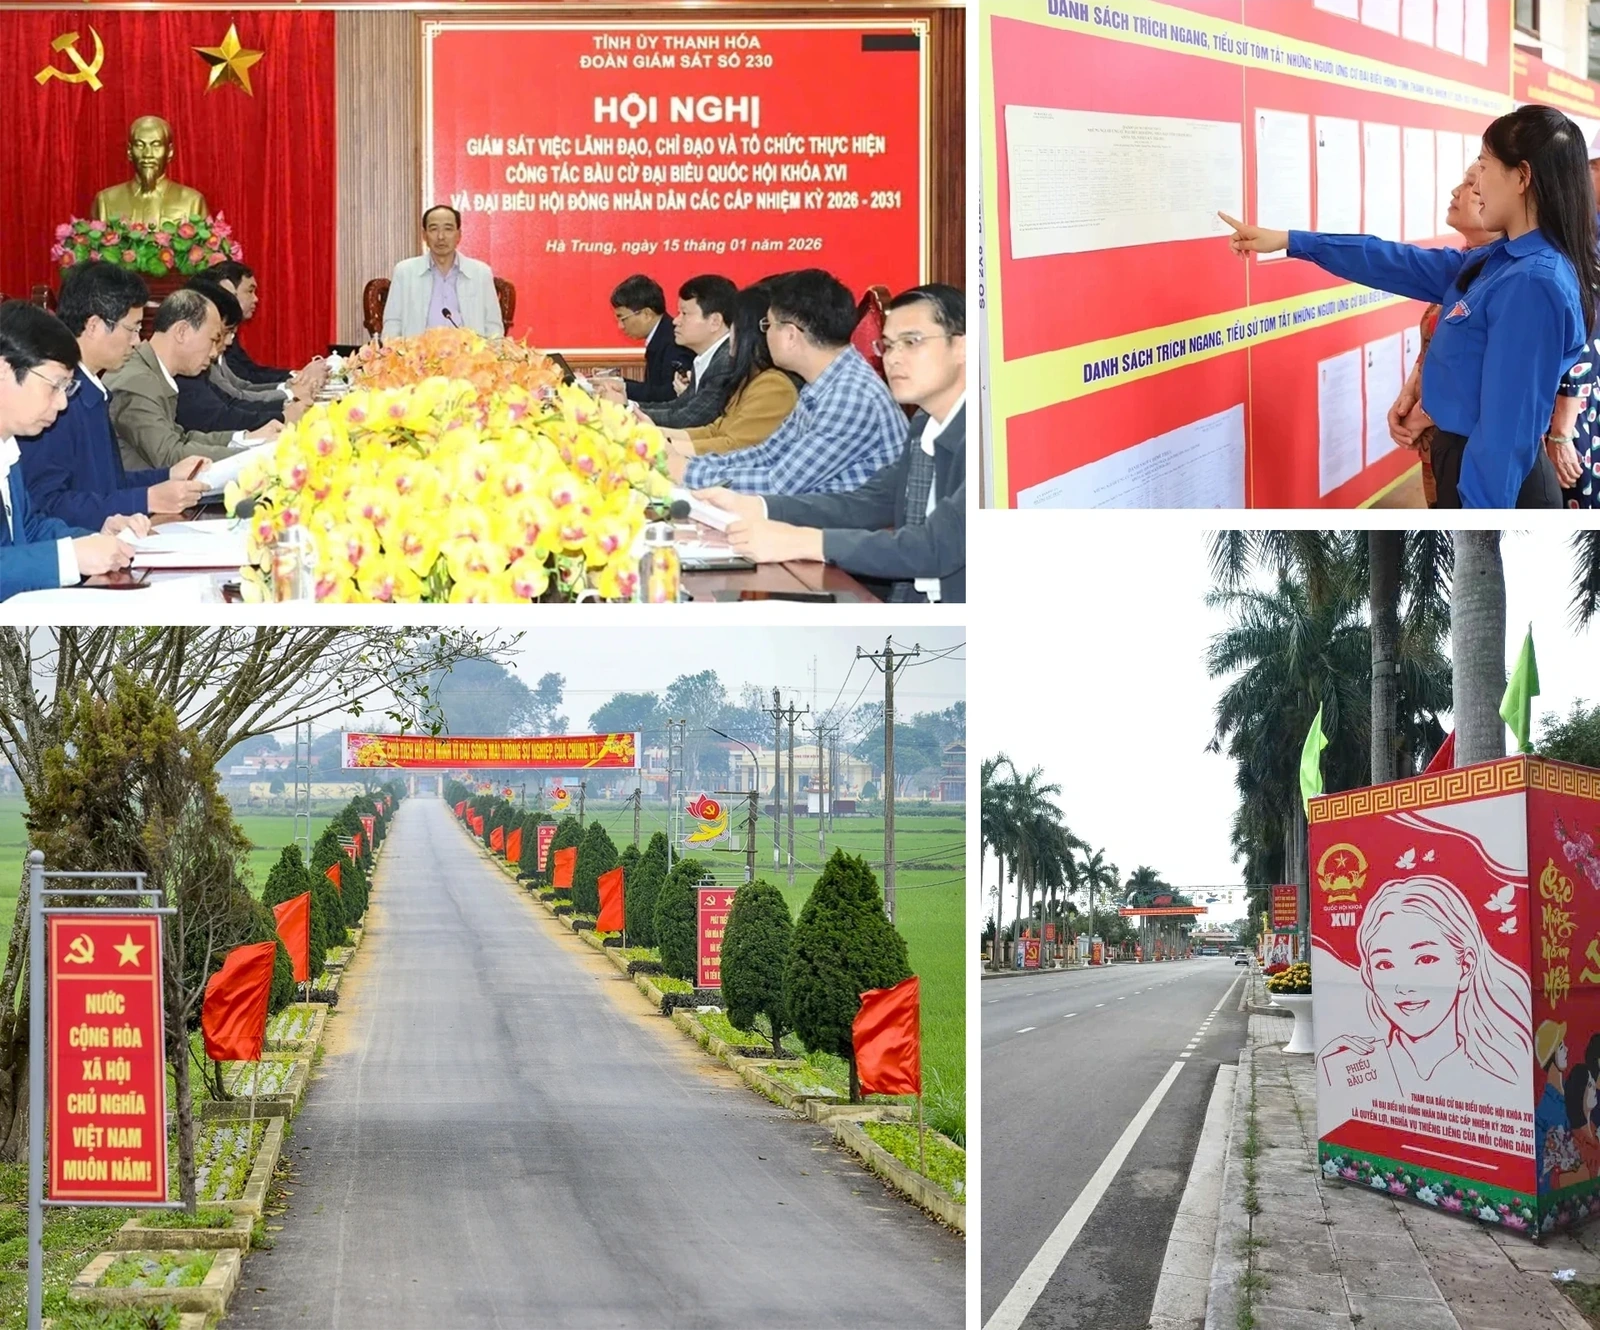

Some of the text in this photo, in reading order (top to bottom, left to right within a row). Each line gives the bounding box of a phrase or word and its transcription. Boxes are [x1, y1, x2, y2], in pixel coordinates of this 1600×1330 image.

[593, 33, 761, 49] TỈNH ỦY THANH HÓA
[1048, 0, 1089, 22] DANH
[1093, 5, 1129, 31] SÁCH
[1133, 16, 1168, 40] TRÍCH
[1170, 25, 1210, 50] NGANG,
[1213, 31, 1234, 54] TIỂU
[1251, 43, 1268, 61] TÓM
[580, 52, 773, 68] ĐOÀN GIÁM SÁT SỐ 230
[594, 92, 760, 129] HỘI NGHỊ
[466, 133, 885, 159] GIÁM SÁT VIỆC LÃNH ĐẠO, CHỈ ĐẠO VÀ TỔ CHỨC THỰC HIỆN
[505, 160, 847, 186] CÔNG TÁC BẦU CỬ ĐẠI BIỂU QUỐC HỘI KHÓA XVI
[450, 187, 901, 214] VÀ ĐẠI BIỂU HỘI ĐỒNG NHÂN DÂN CÁC CẤP NHIỆM KỲ 2026 2031
[545, 238, 822, 255] Hà Trung, ngày 15 tháng 01 năm 2026
[1083, 357, 1118, 383] DANH
[1122, 349, 1153, 372] SÁCH
[1156, 339, 1185, 363] TRÍCH
[1189, 330, 1224, 353] NGANG,
[1227, 319, 1244, 342] TIỂU
[1247, 316, 1258, 337] SỬ
[1260, 315, 1275, 333] TÓM
[1278, 309, 1290, 328] TẮT
[1331, 912, 1355, 927] XVI
[86, 990, 125, 1015] NƯỚC
[69, 1023, 142, 1052] CỘNG HÒA
[82, 1056, 131, 1085] XÃ HỘI
[1346, 1058, 1370, 1074] PHIẾU
[1347, 1069, 1377, 1087] BẦU CỬ
[67, 1087, 146, 1115] CHỦ NGHĨA
[1411, 1093, 1424, 1102] THAM
[1426, 1095, 1434, 1104] GIA
[1479, 1103, 1494, 1116] QUỐC
[1495, 1106, 1504, 1119] HỘI
[1523, 1112, 1533, 1123] XVI
[72, 1123, 142, 1152] VIỆT NAM
[1351, 1107, 1358, 1117] LÀ
[1390, 1114, 1408, 1128] NGHĨA
[1419, 1121, 1440, 1134] THIÊNG
[1442, 1125, 1461, 1138] LIÊNG
[1463, 1127, 1476, 1142] CỦA
[1478, 1131, 1492, 1146] MỖI
[1494, 1136, 1514, 1150] CÔNG
[1515, 1140, 1534, 1155] DÂN!
[1500, 1124, 1514, 1135] 2026
[1520, 1127, 1533, 1139] 2031
[63, 1156, 151, 1181] MUÔN NĂM!
